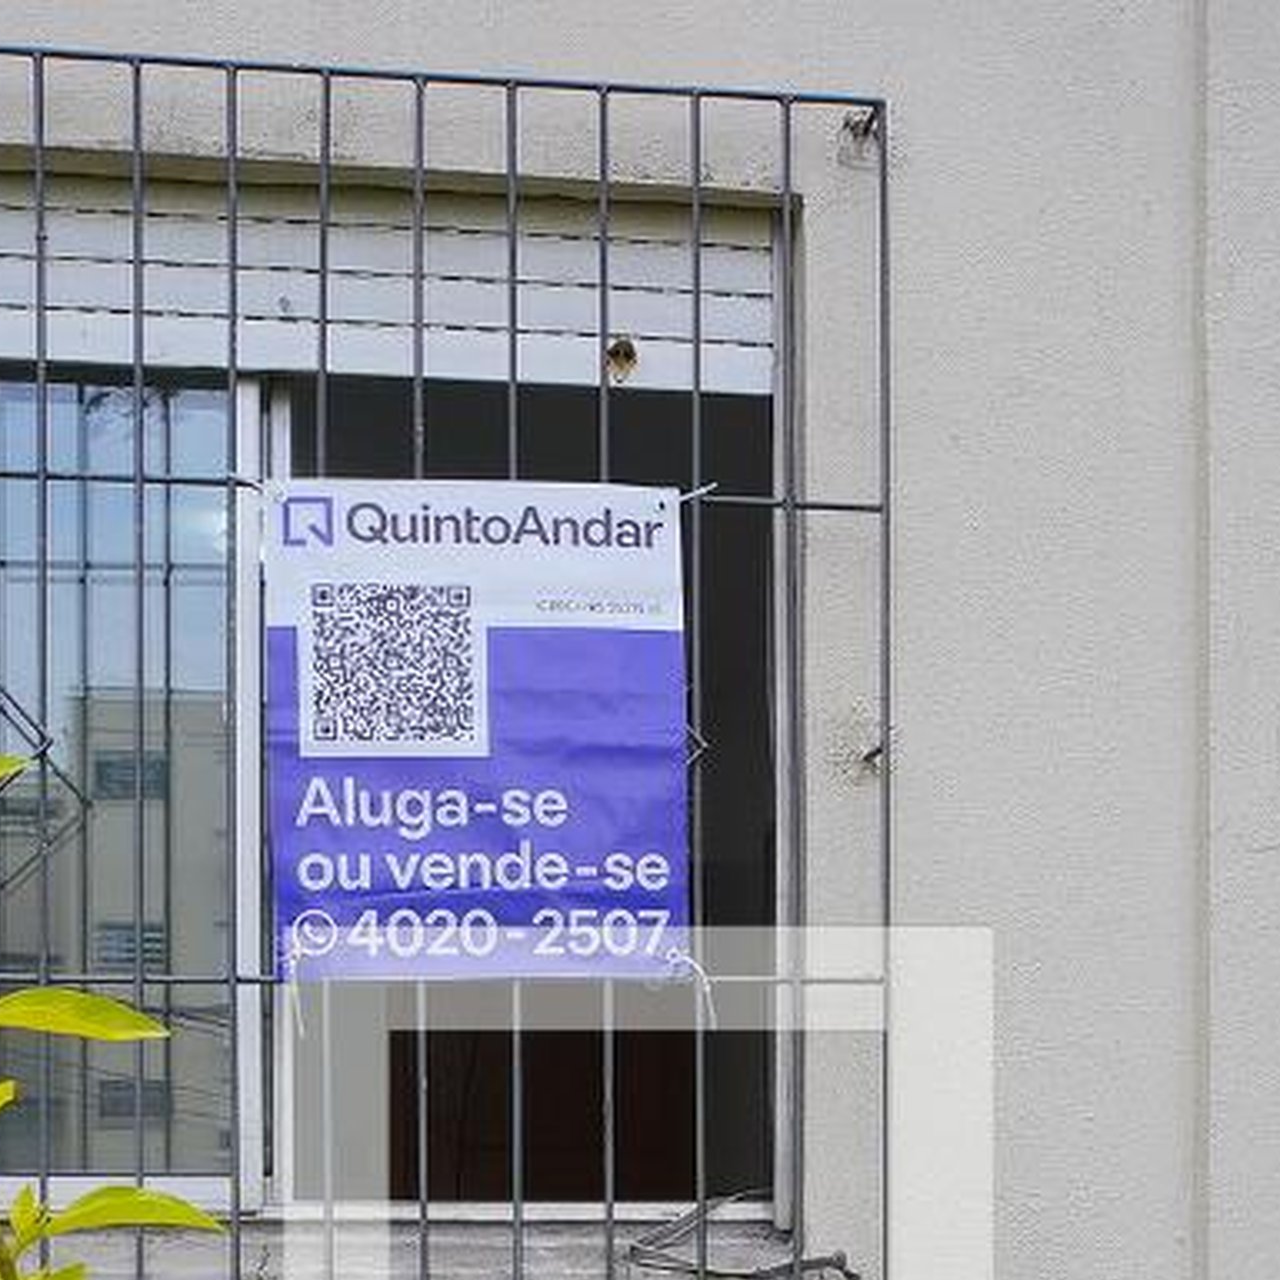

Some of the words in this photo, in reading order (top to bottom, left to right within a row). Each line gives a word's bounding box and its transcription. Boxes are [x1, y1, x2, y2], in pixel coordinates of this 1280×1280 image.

[346, 502, 664, 549] QuintoAndar
[296, 776, 569, 839] Aluga-se
[296, 851, 372, 891] ou
[385, 839, 670, 891] vende-se
